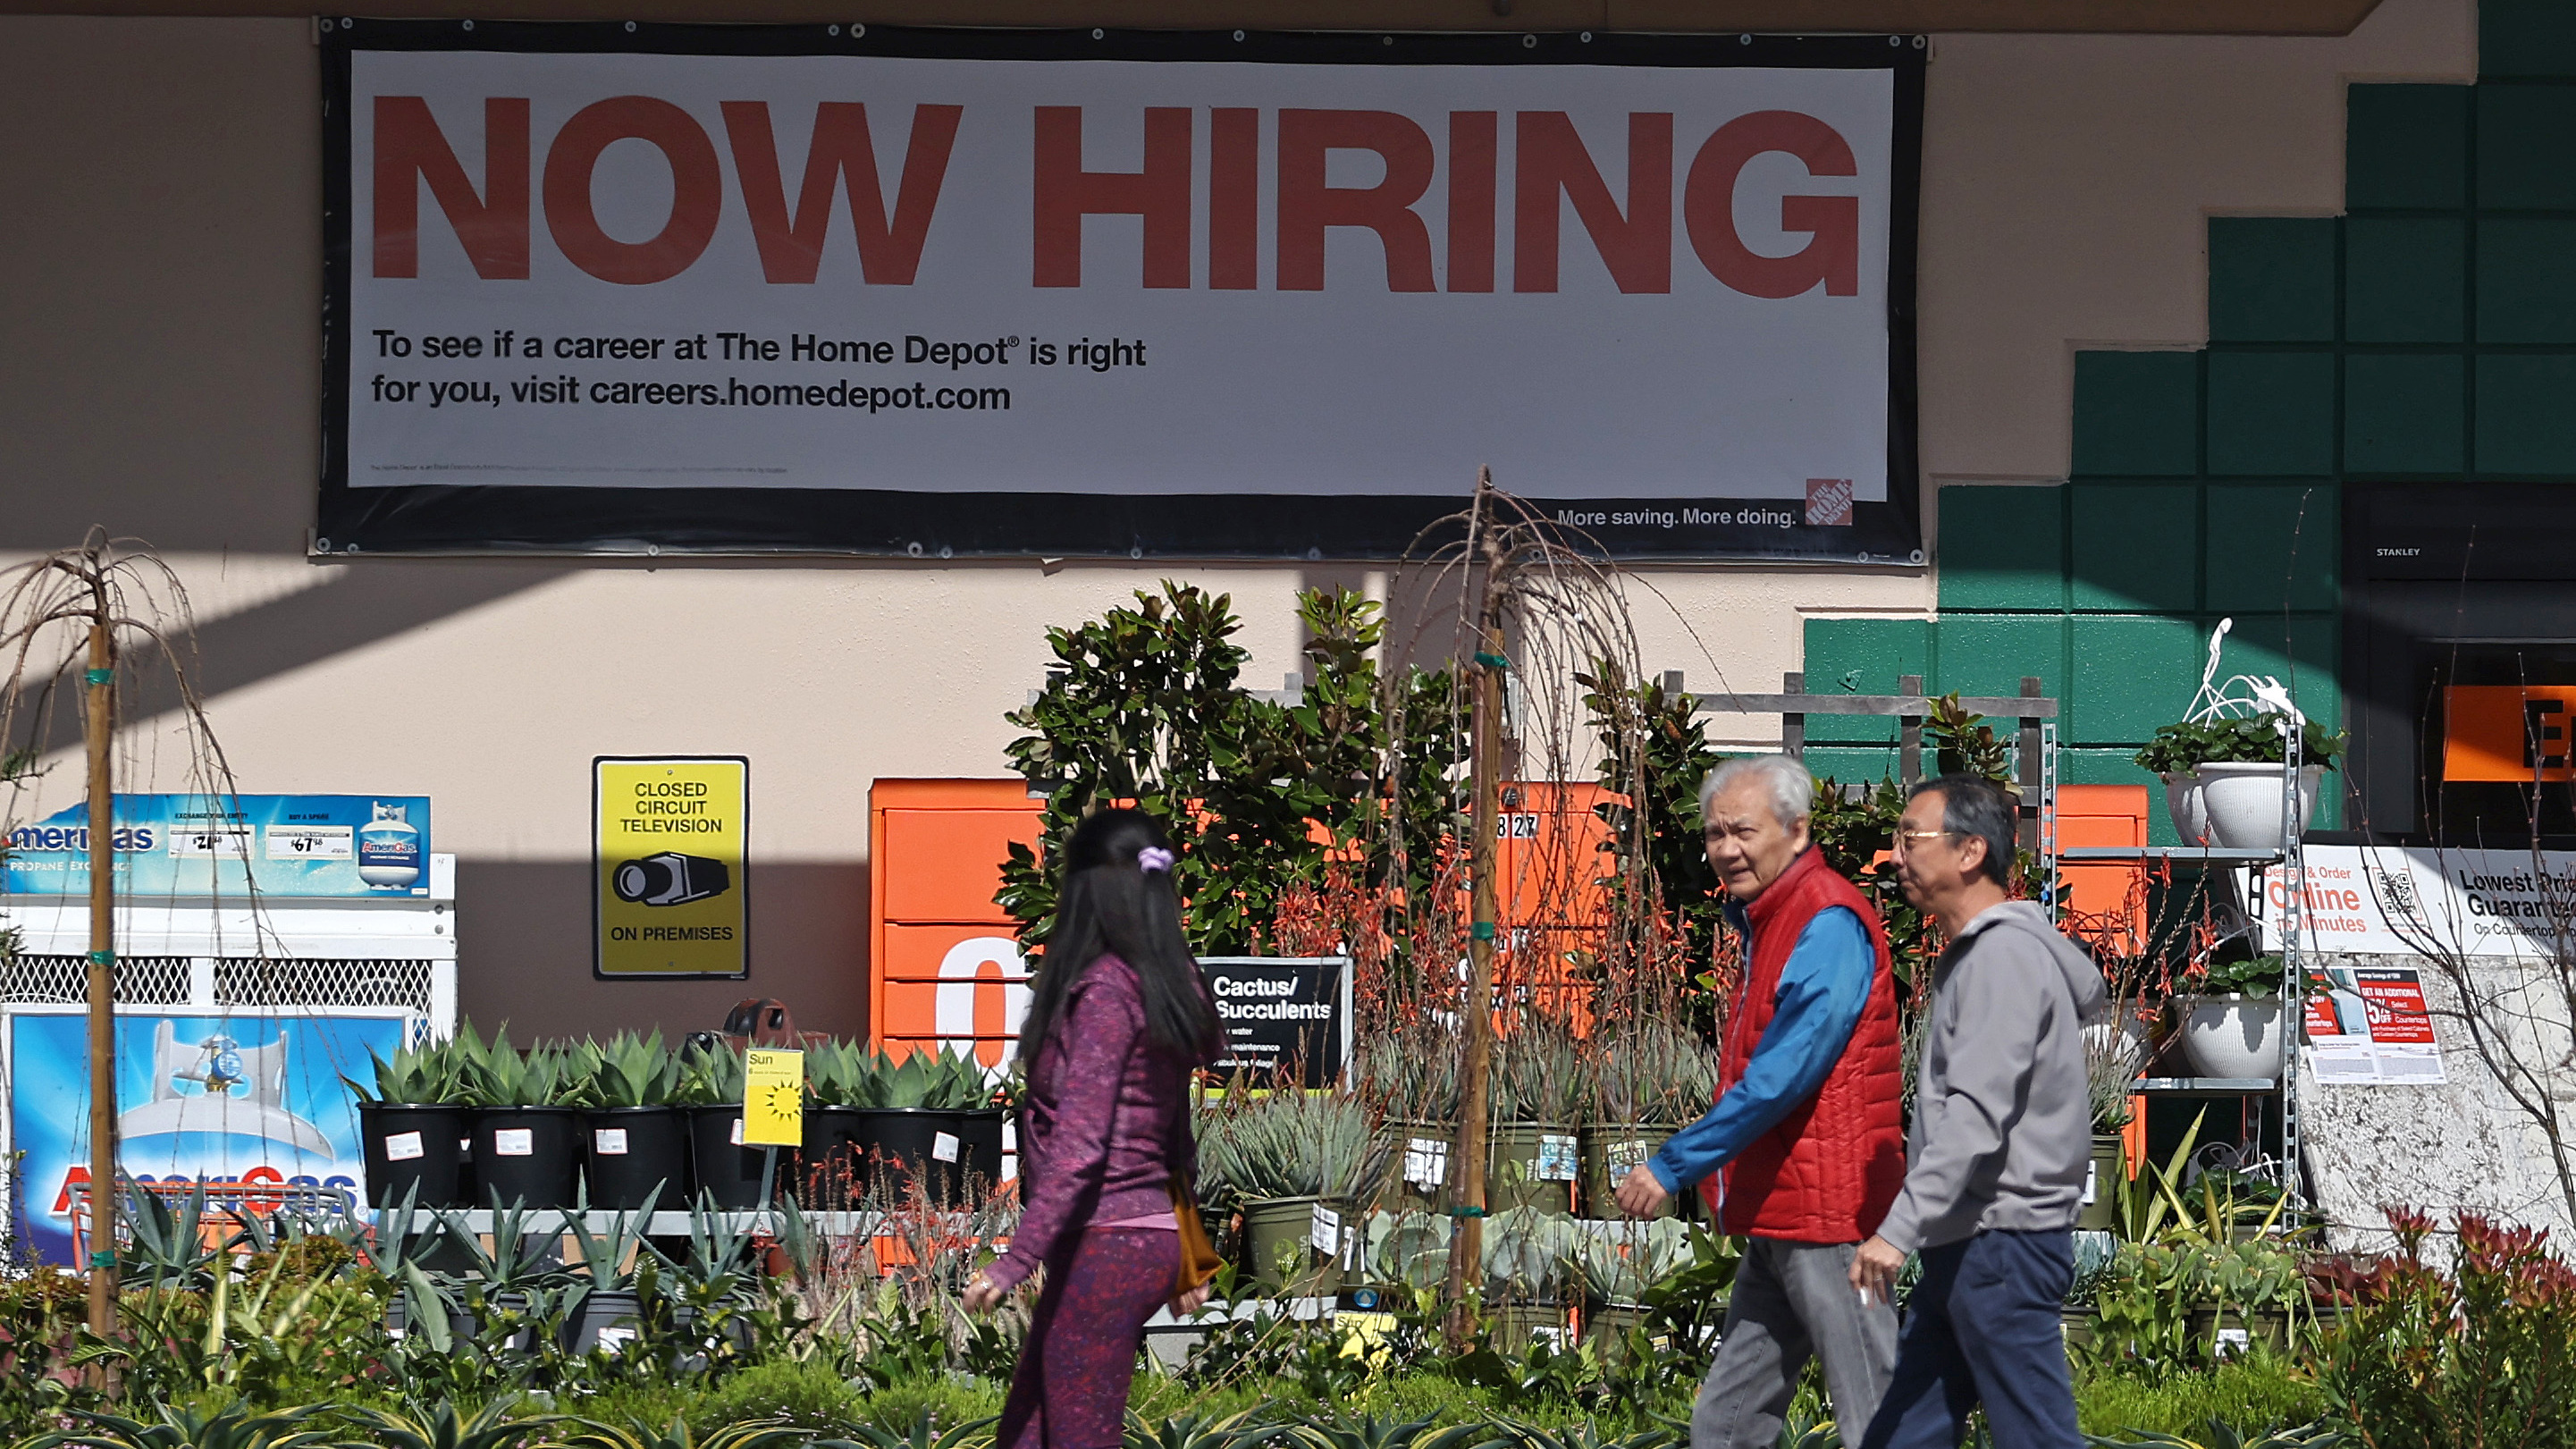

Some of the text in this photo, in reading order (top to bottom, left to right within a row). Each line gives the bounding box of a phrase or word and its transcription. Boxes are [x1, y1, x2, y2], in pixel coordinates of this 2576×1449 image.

[373, 95, 1860, 299] NOW HIRING
[372, 329, 412, 358] To
[422, 336, 484, 358] see
[493, 329, 515, 358] if
[522, 337, 543, 358] a
[553, 337, 666, 360] career
[674, 333, 708, 360] at
[715, 332, 780, 362] The
[791, 333, 895, 364] Home
[1030, 336, 1057, 366] is
[1067, 337, 1147, 373] right
[371, 374, 1011, 415] for you, visit careers.homedepot.com
[1806, 479, 1853, 526] HOME
[1558, 508, 1797, 529] More saving. More doing.
[2377, 548, 2420, 556] STANLEY
[635, 783, 708, 797] CLOSED
[636, 801, 707, 814] CIRCUIT
[620, 819, 723, 832] TELEVISION
[2, 825, 154, 849] merias
[10, 862, 64, 872] PROPANE
[2307, 867, 2316, 879] &
[2319, 867, 2352, 879] Order
[2459, 870, 2535, 892] Lowest
[2299, 913, 2368, 932] Minutes
[610, 927, 734, 940] ON PREMISES
[1213, 975, 1299, 997] Cactus/
[2361, 987, 2421, 998] GET AN ADDITIONAL
[1216, 998, 1332, 1019] Succulents
[2380, 1014, 2428, 1024] OFF Countertops
[1231, 1027, 1253, 1035] water
[1230, 1043, 1281, 1052] maintenance
[748, 1053, 773, 1066] Sun
